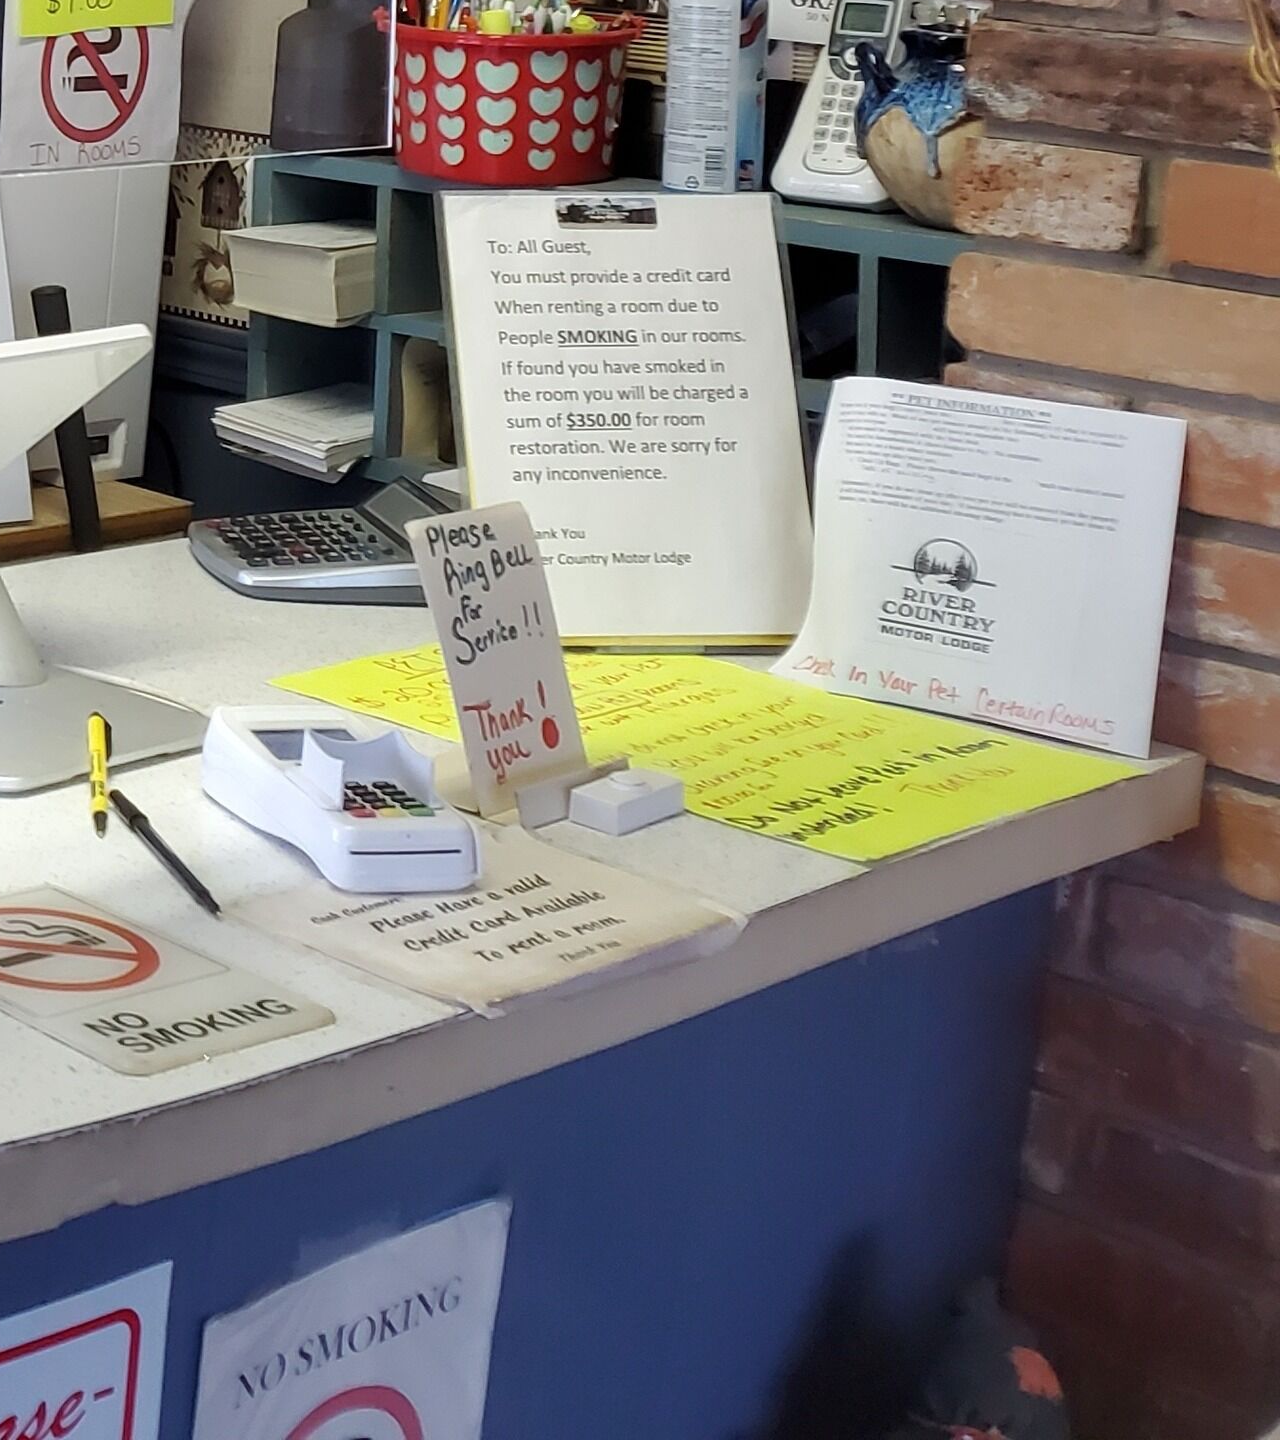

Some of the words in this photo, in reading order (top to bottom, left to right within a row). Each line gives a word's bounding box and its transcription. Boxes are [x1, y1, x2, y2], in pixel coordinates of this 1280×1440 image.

[29, 142, 59, 167] IN
[73, 136, 143, 164] ROOMS
[487, 241, 512, 254] To:
[517, 240, 537, 254] All
[541, 240, 591, 255] Guest,
[491, 271, 522, 284] You
[526, 271, 566, 283] must
[571, 269, 629, 286] provide
[646, 269, 692, 283] credit
[696, 268, 731, 282] card
[494, 300, 543, 314] When
[547, 300, 603, 316] renting
[621, 303, 664, 313] room
[668, 299, 698, 312] due
[498, 330, 554, 347] People
[557, 329, 638, 345] SMOKING
[661, 332, 688, 343] our
[692, 331, 746, 343] rooms.
[517, 360, 564, 375] found
[568, 363, 598, 378] you
[603, 359, 641, 373] have
[645, 359, 706, 373] smoked
[504, 388, 531, 401] the
[535, 390, 579, 401] room
[583, 389, 613, 404] you
[617, 386, 645, 400] will
[673, 385, 735, 402] charged
[937, 399, 1036, 418] INFORMATION
[506, 417, 541, 428] sum
[566, 412, 632, 429] $350.00
[636, 412, 659, 426] for
[663, 415, 706, 426] room
[510, 440, 605, 455] restoration.
[641, 441, 667, 453] are
[671, 441, 710, 456] sorry
[715, 438, 737, 453] for
[512, 469, 542, 484] any
[546, 465, 667, 481] inconvenience.
[426, 522, 497, 557] Please
[561, 528, 586, 540] You
[557, 551, 609, 567] Country
[611, 551, 651, 564] Motor
[653, 551, 692, 566] Lodge
[443, 557, 490, 596] Ring
[902, 586, 977, 614] RIVER
[881, 599, 996, 633] COUNTRY
[879, 624, 935, 643] MOTOR
[941, 636, 990, 654] LODGE
[849, 664, 868, 683] In
[878, 670, 918, 697] Your
[928, 677, 960, 703] Pet
[972, 686, 1046, 724] Certain
[463, 698, 533, 741] Thank
[486, 740, 531, 785] you
[369, 909, 435, 934] Please
[436, 894, 484, 914] Have
[506, 873, 551, 896] valid
[403, 928, 470, 953] Credit
[469, 910, 521, 934] Card
[523, 890, 606, 918] Available
[474, 949, 503, 963] To
[508, 932, 551, 955] rent
[571, 918, 627, 936] room.
[84, 1011, 150, 1039] NO
[118, 997, 298, 1055] SMOKING
[235, 1353, 289, 1409] NO
[292, 1275, 463, 1376] SMOKING
